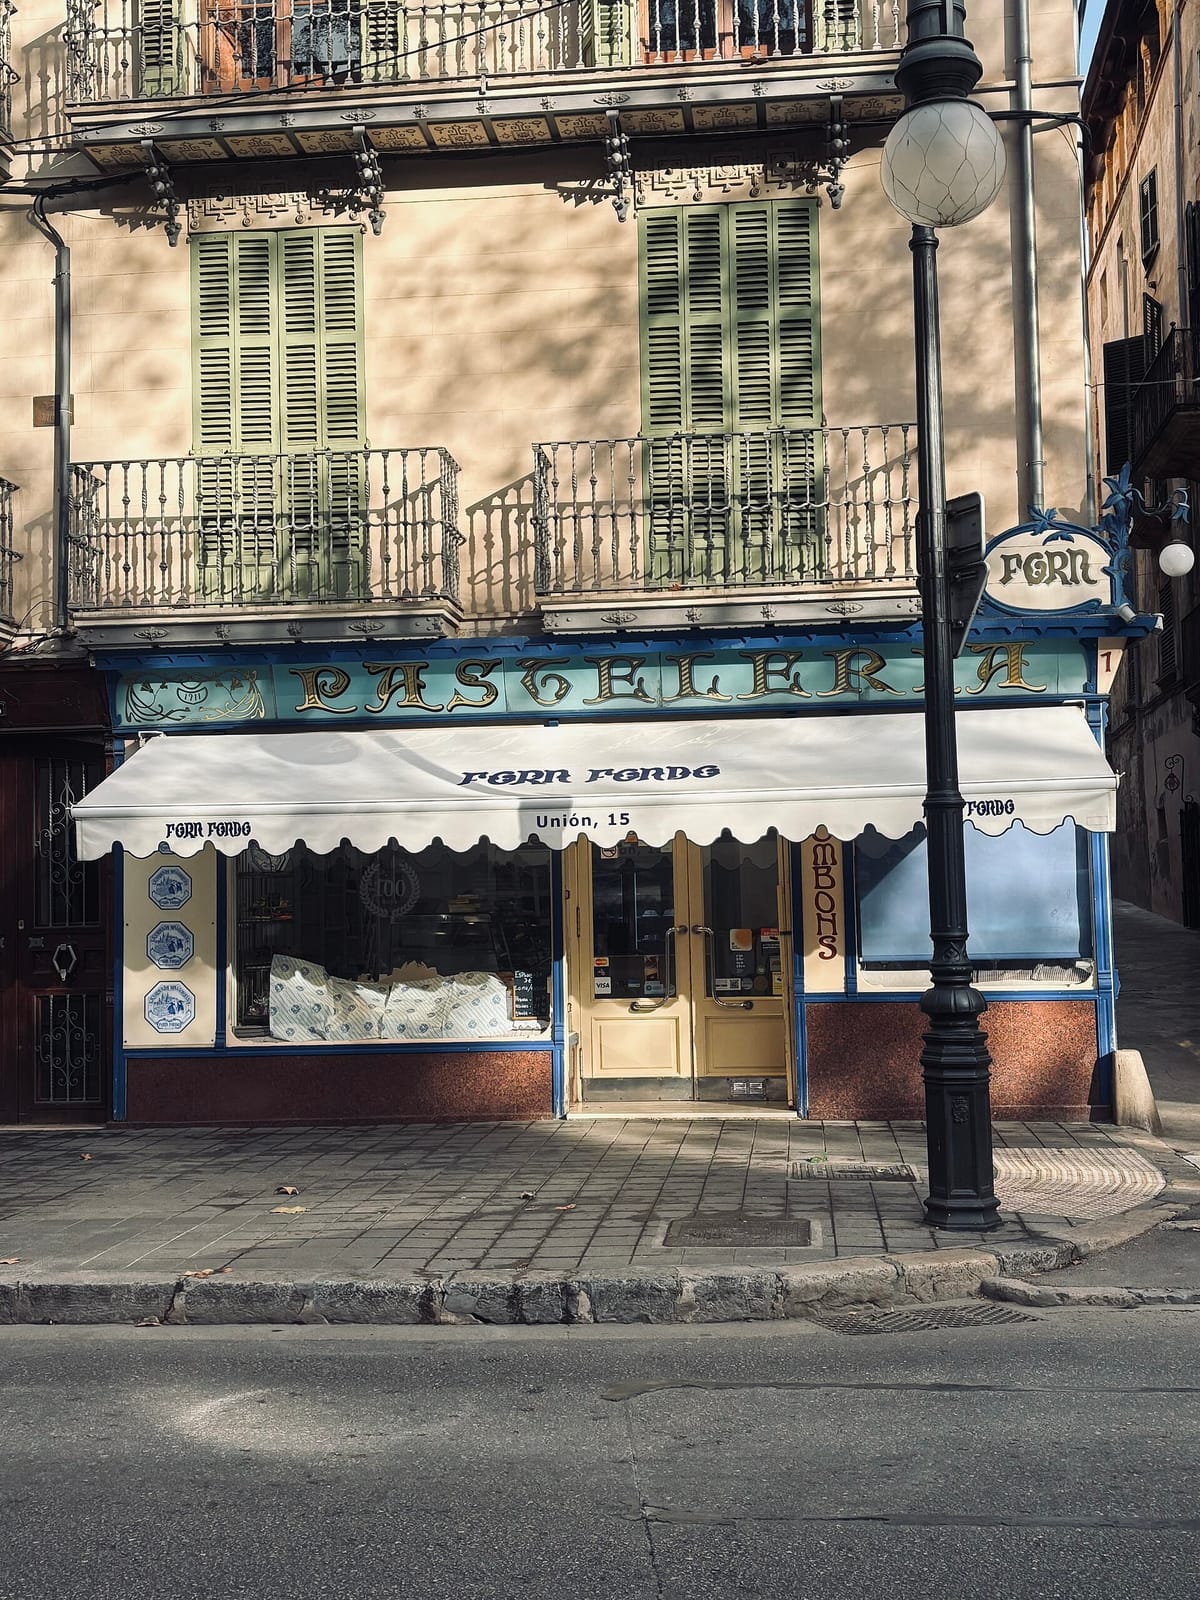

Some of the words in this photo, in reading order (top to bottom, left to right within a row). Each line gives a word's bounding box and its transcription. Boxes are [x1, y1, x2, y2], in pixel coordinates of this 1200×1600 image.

[999, 548, 1097, 586] FORN
[457, 769, 572, 786] FORN
[585, 765, 721, 784] FONDO
[965, 799, 1015, 817] FONDO
[536, 813, 599, 829] Unión,
[608, 812, 630, 826] 15
[166, 822, 204, 839] FORN
[207, 822, 252, 837] FONDO
